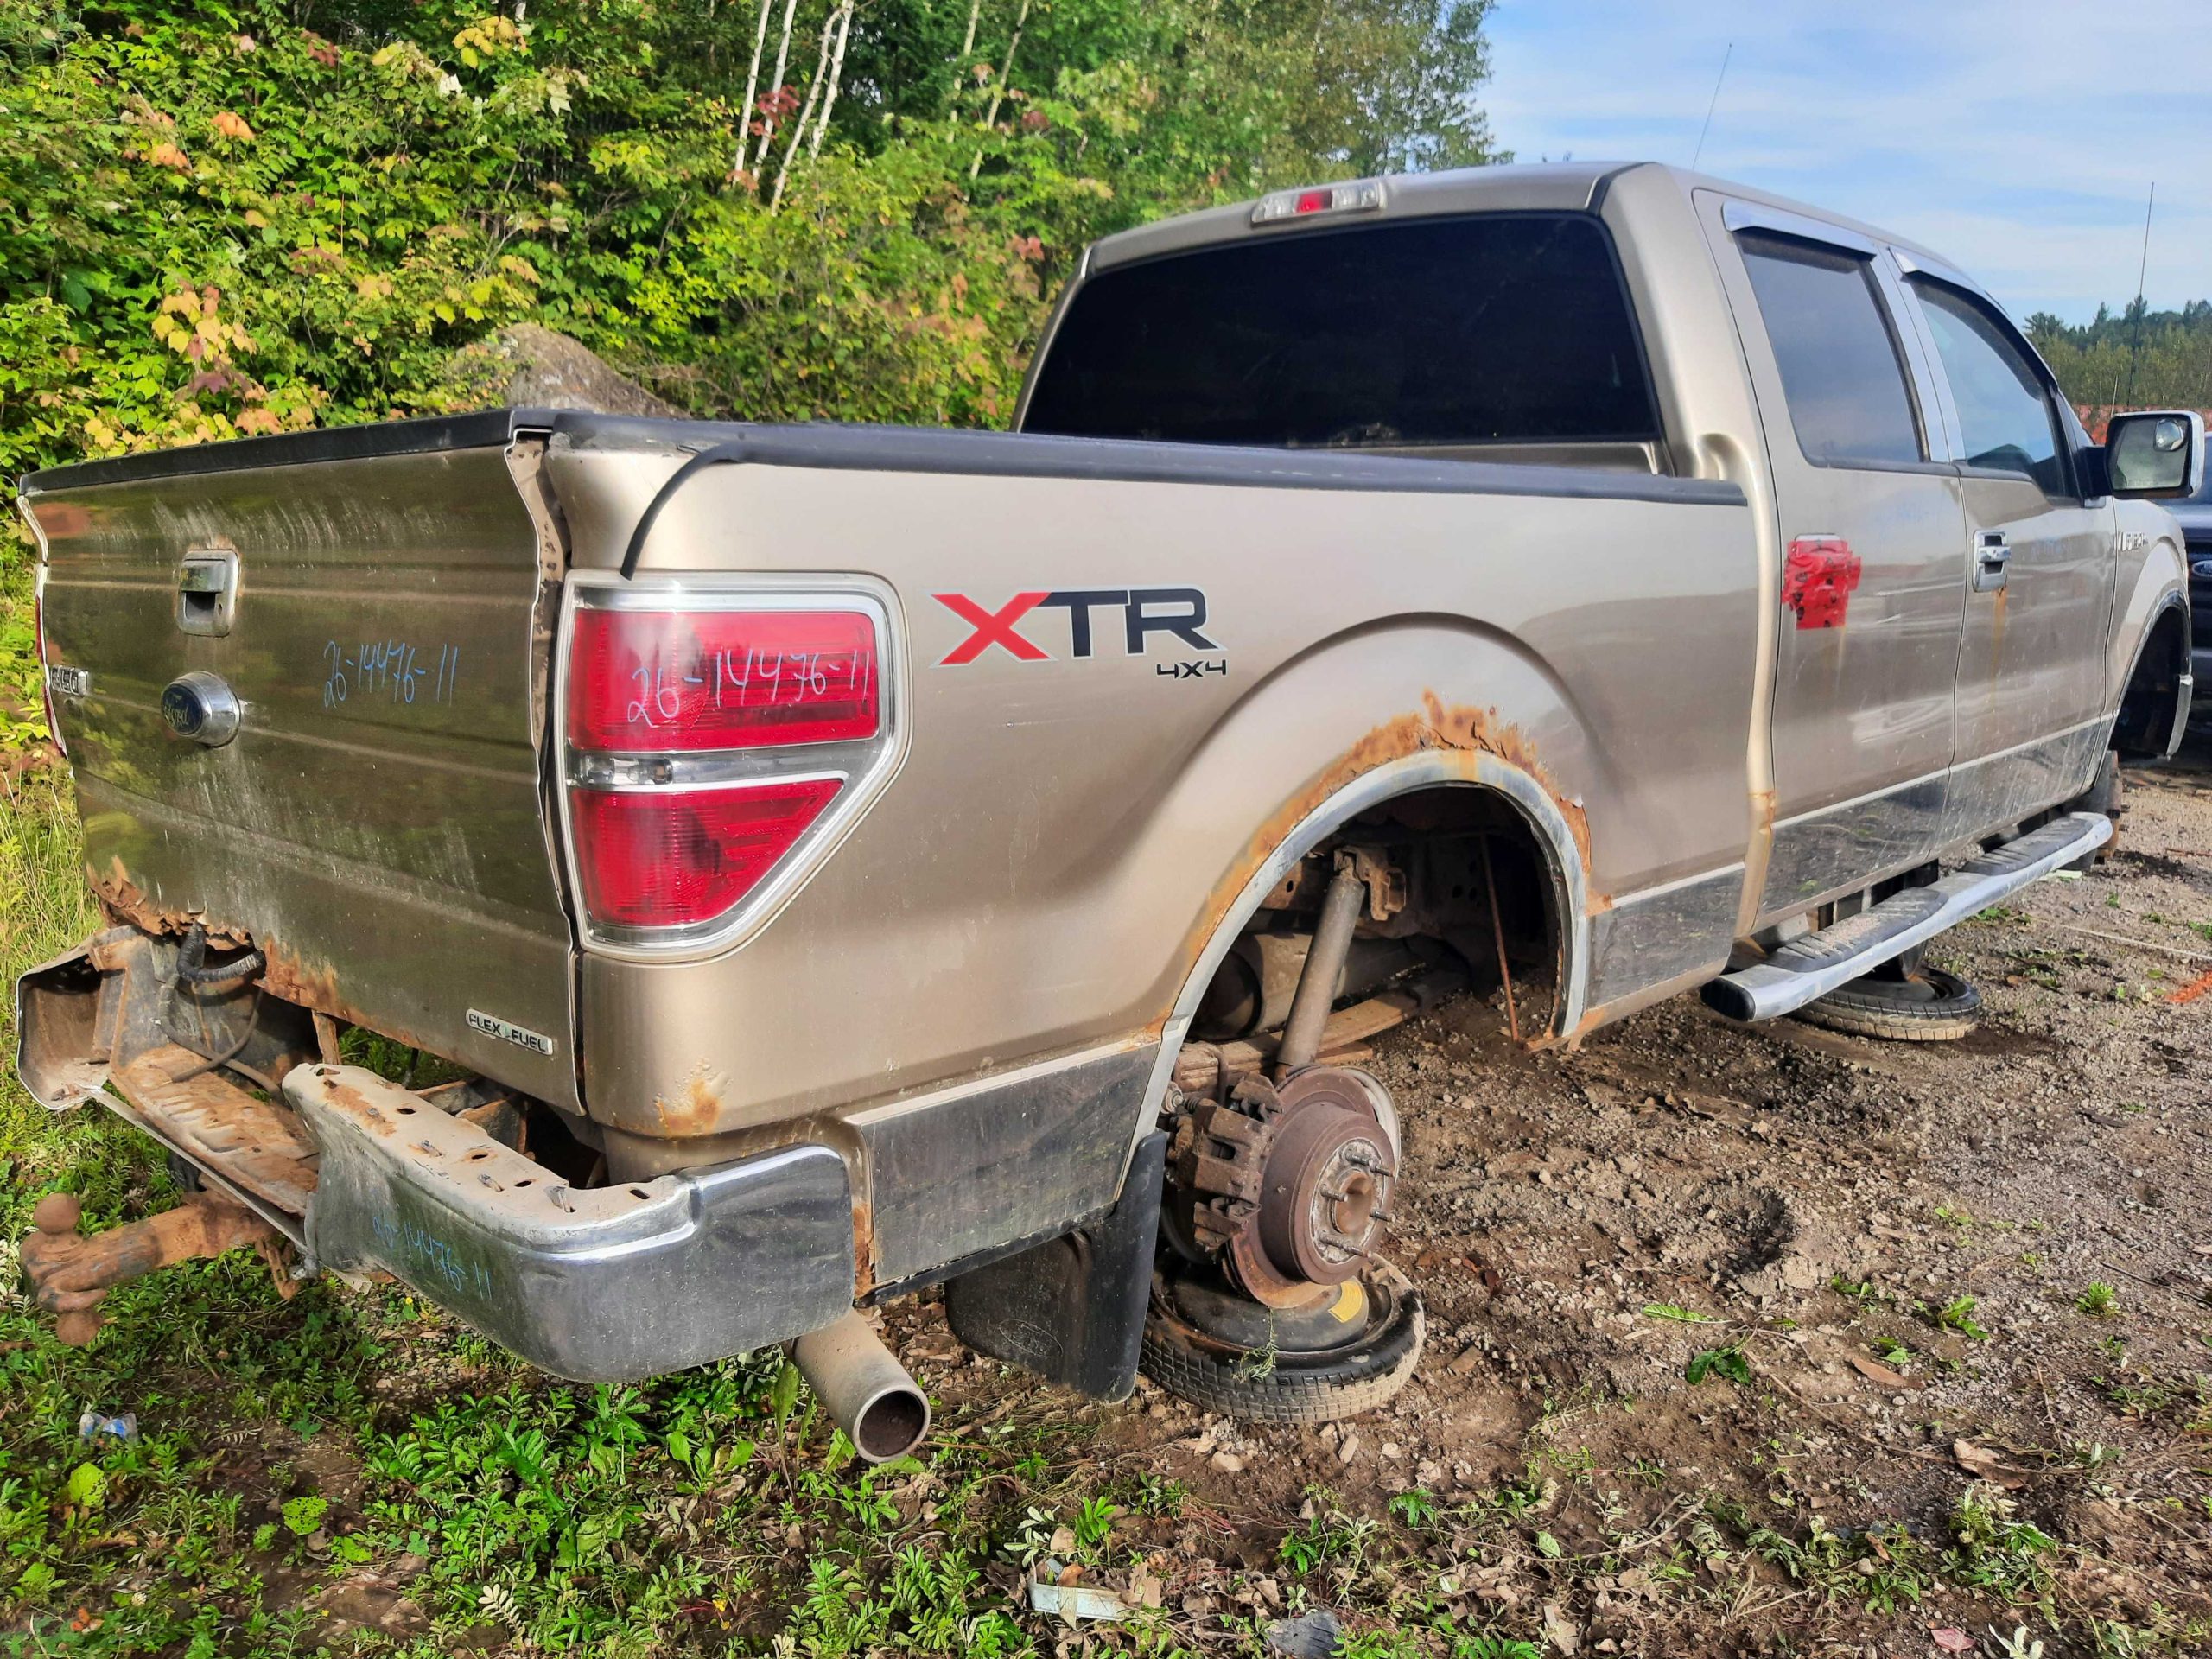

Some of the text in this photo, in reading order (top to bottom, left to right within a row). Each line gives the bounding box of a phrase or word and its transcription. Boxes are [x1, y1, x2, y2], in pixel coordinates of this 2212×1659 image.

[929, 588, 1223, 666] XTR
[468, 1013, 546, 1052] FLEX FUEL
